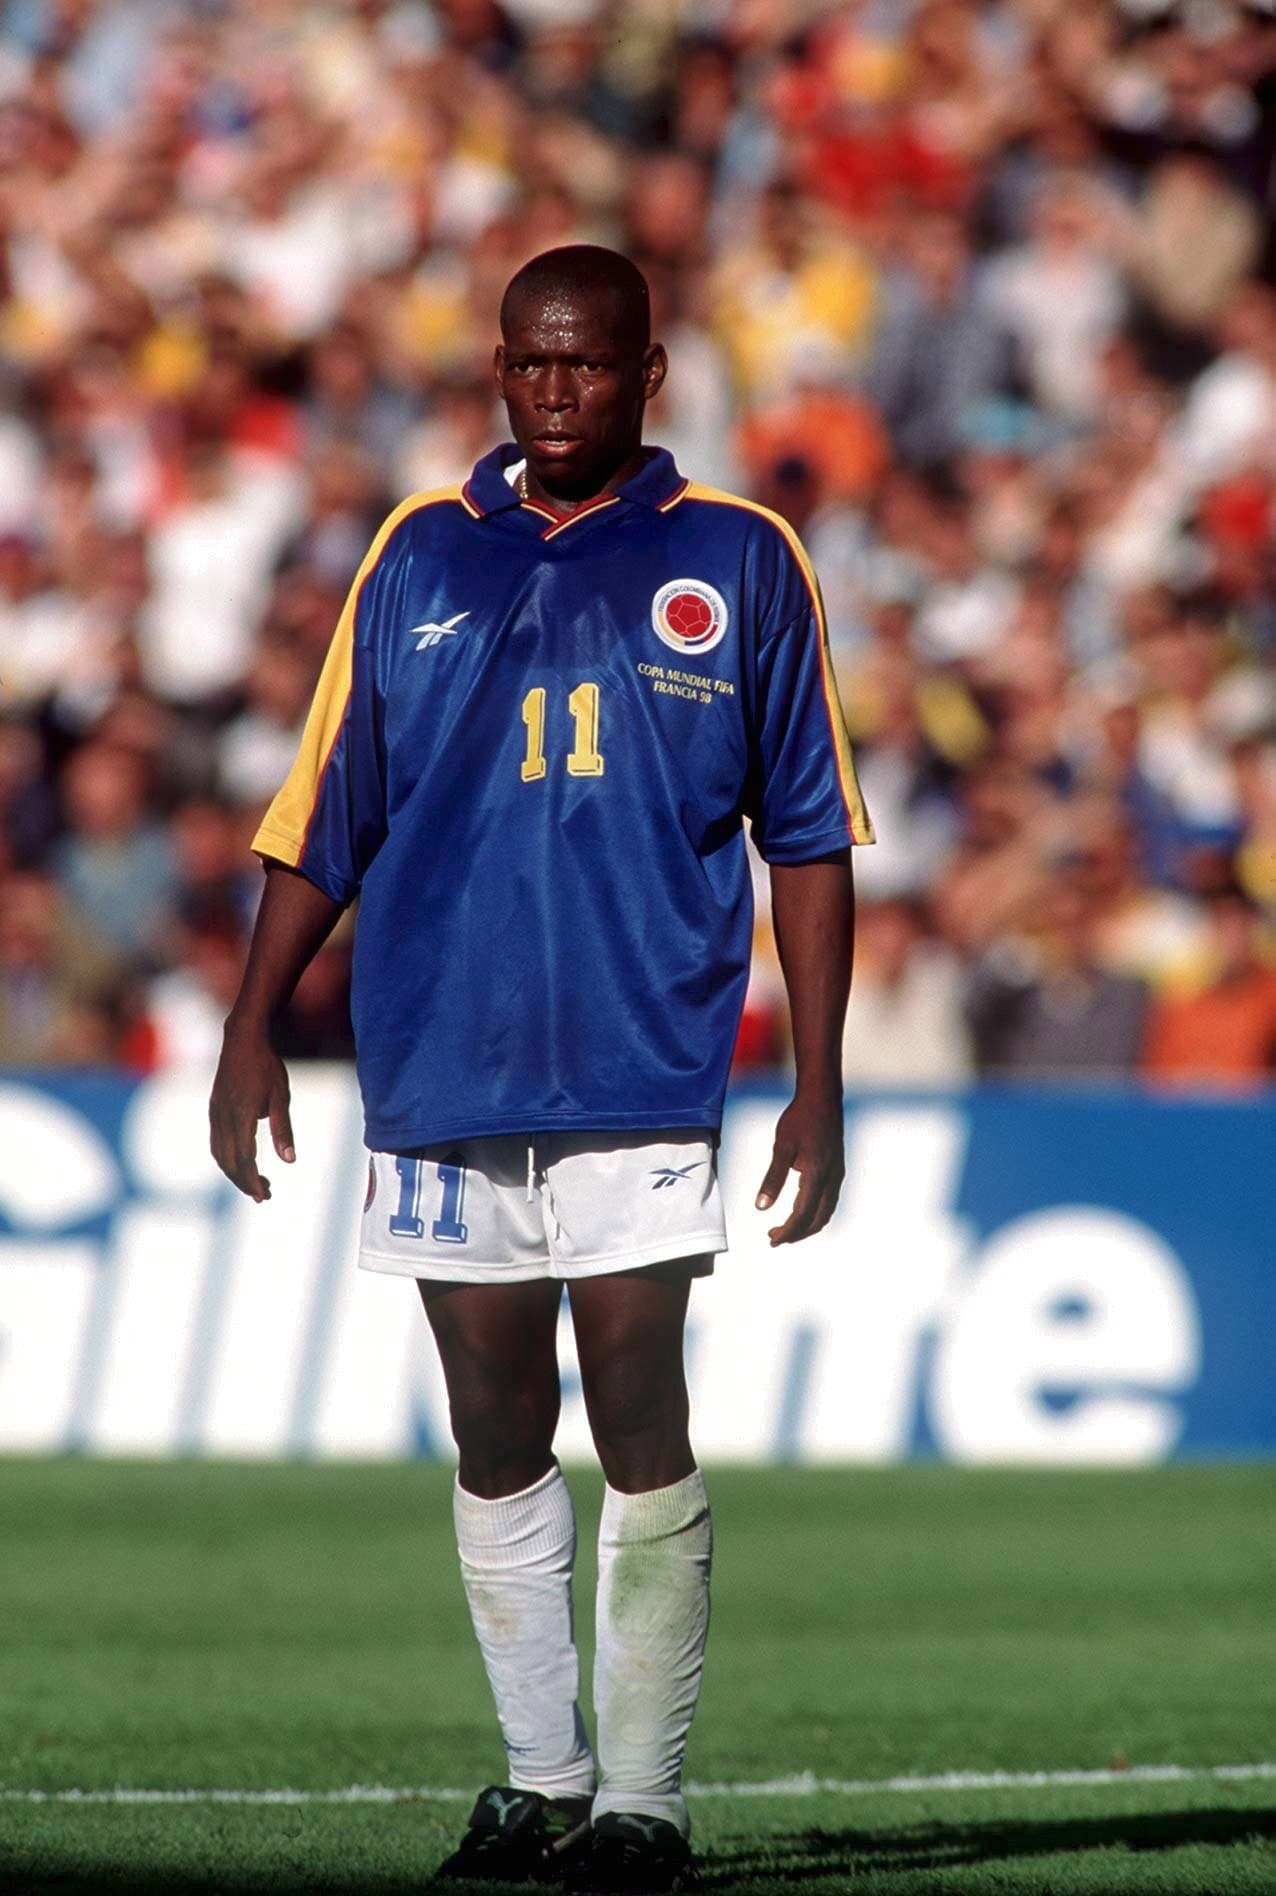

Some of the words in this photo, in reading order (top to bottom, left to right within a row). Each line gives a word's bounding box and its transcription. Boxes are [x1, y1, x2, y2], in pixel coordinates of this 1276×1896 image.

[637, 662, 664, 679] COPA
[666, 669, 712, 690] MUNDIAL
[713, 680, 735, 695] FIFA
[653, 681, 698, 700] FRANCIA
[699, 691, 712, 704] 98
[521, 682, 604, 783] 11
[389, 1148, 468, 1244] 11
[0, 1058, 1197, 1462] illtte
